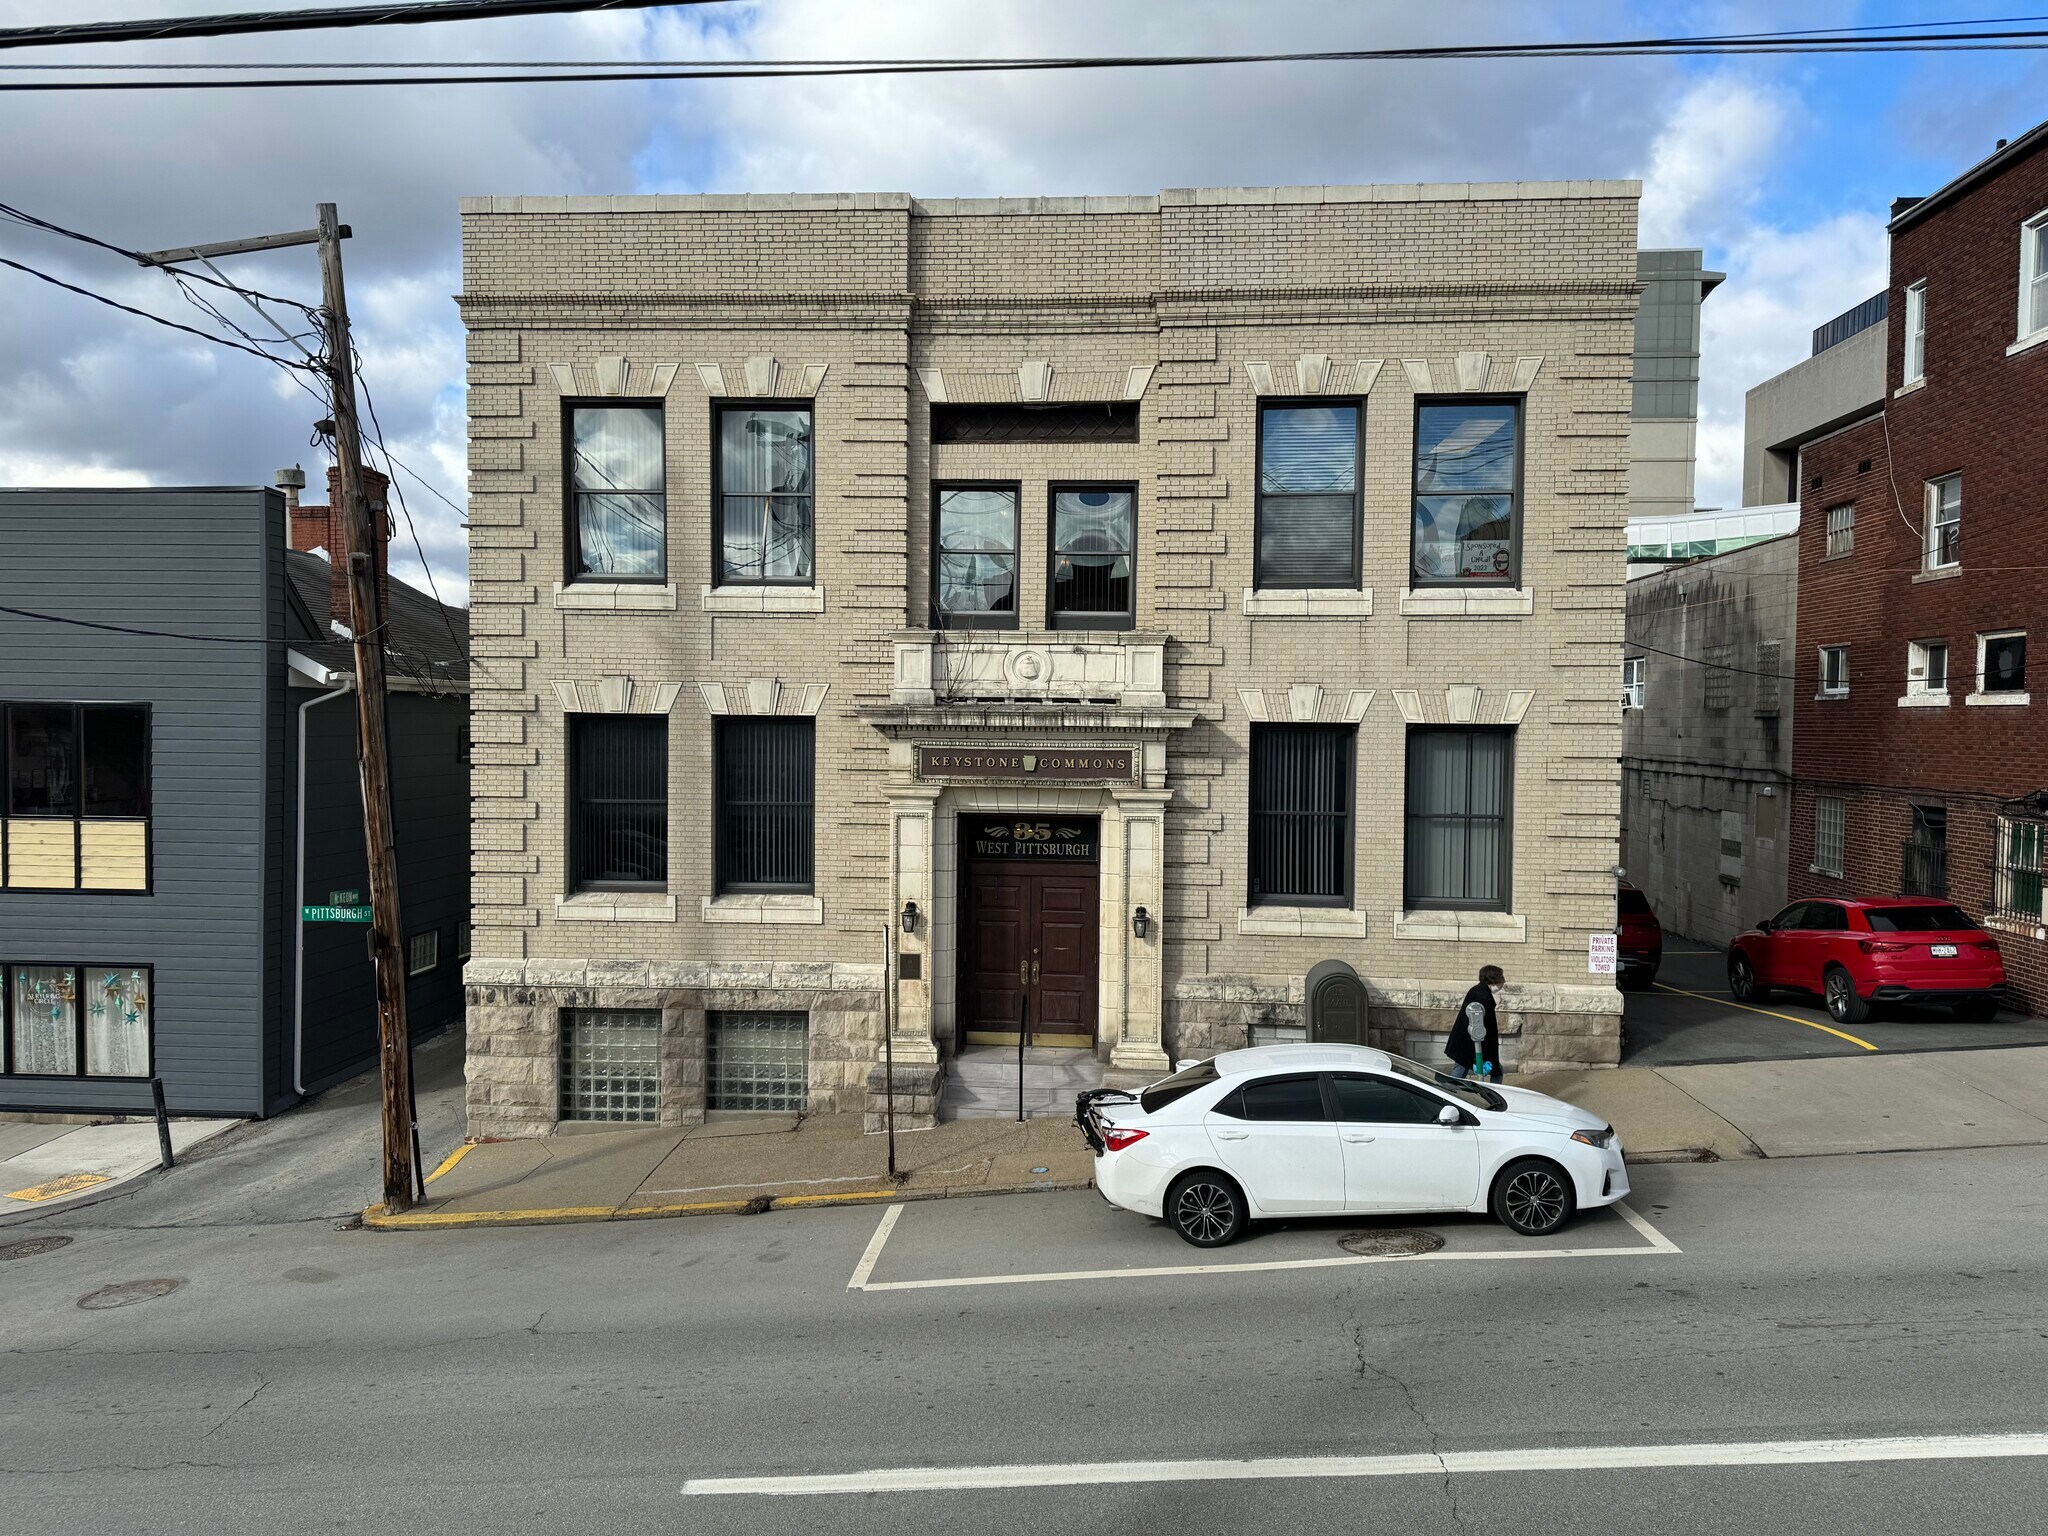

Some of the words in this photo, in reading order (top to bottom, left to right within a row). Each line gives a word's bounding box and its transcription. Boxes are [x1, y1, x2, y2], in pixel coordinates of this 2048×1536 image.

[931, 756, 1020, 768] KEYSTONE
[1039, 758, 1126, 770] COMMONS
[1013, 822, 1052, 841] 35
[311, 908, 363, 919] PITTSBURGH
[1591, 945, 1614, 953] PARKING
